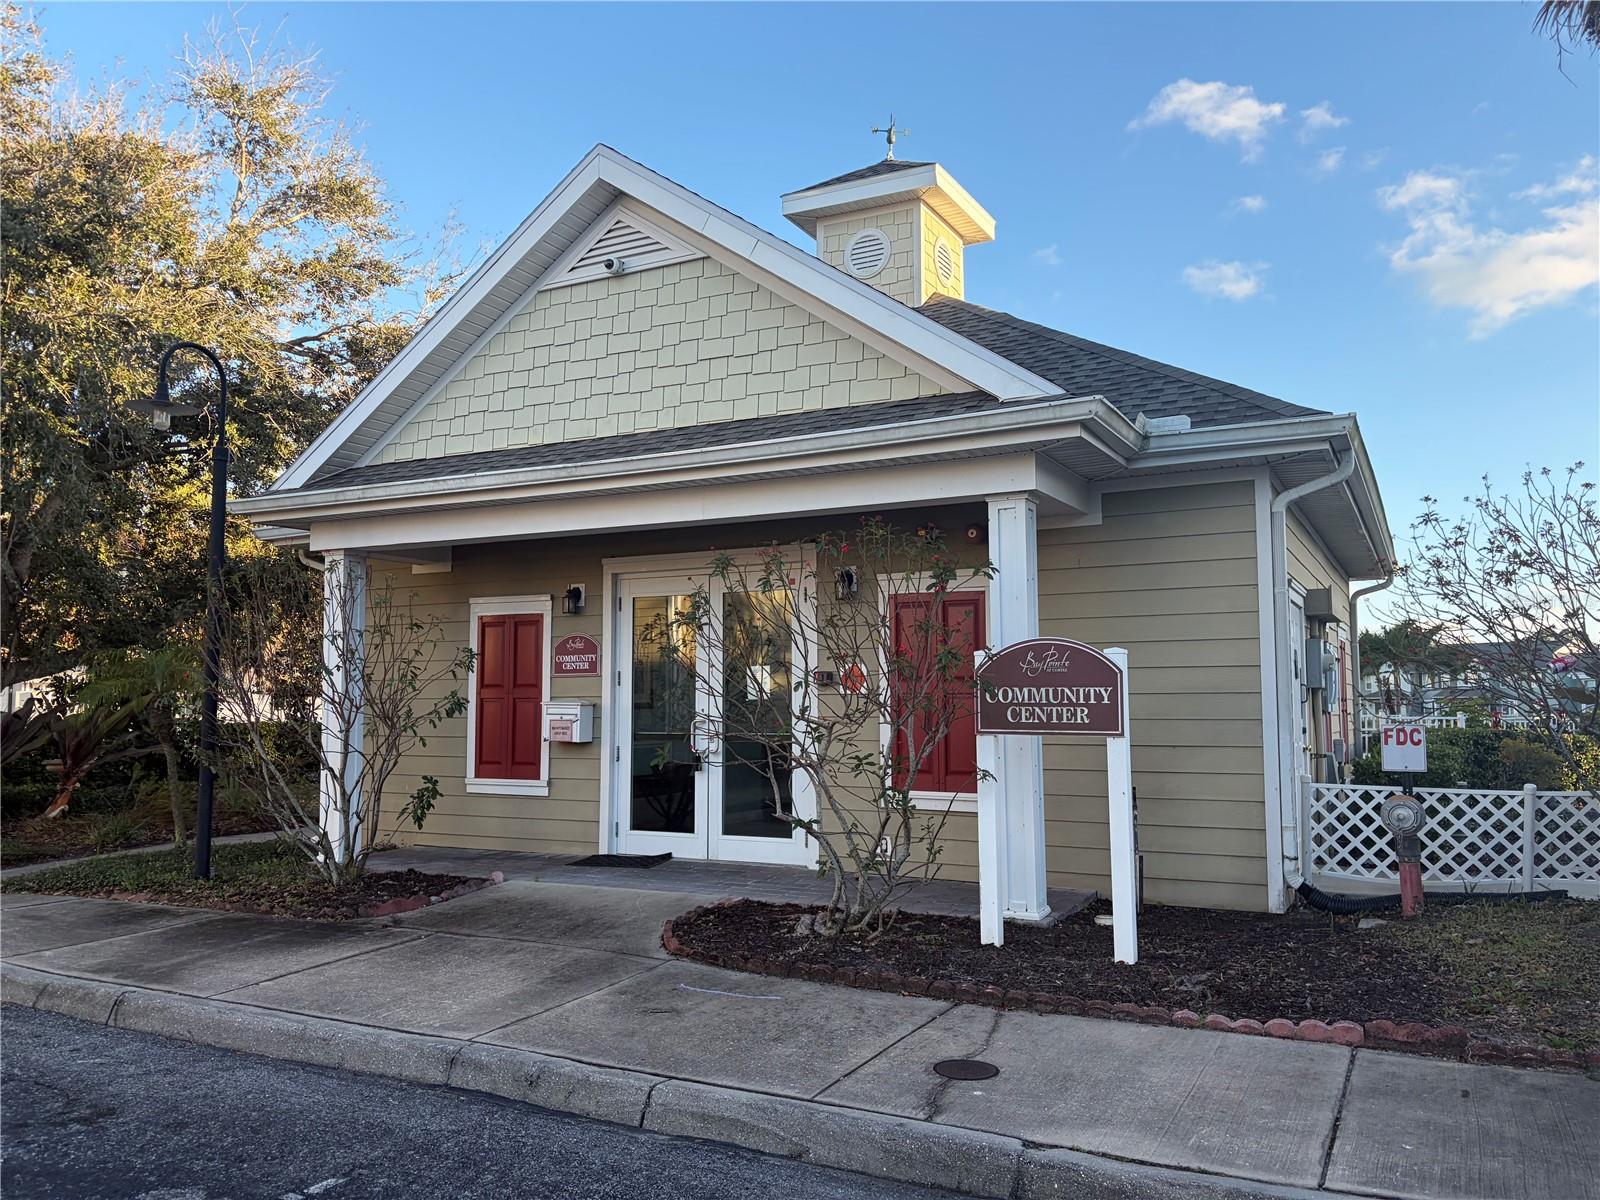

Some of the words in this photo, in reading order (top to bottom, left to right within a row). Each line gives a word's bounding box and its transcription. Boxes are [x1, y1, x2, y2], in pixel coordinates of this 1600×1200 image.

[555, 654, 596, 663] COMMUNITY
[562, 662, 590, 670] CENTER
[1019, 650, 1044, 677] Bay
[1042, 645, 1071, 670] Pointe
[1006, 706, 1091, 724] CENTER
[1383, 727, 1422, 747] FDC
